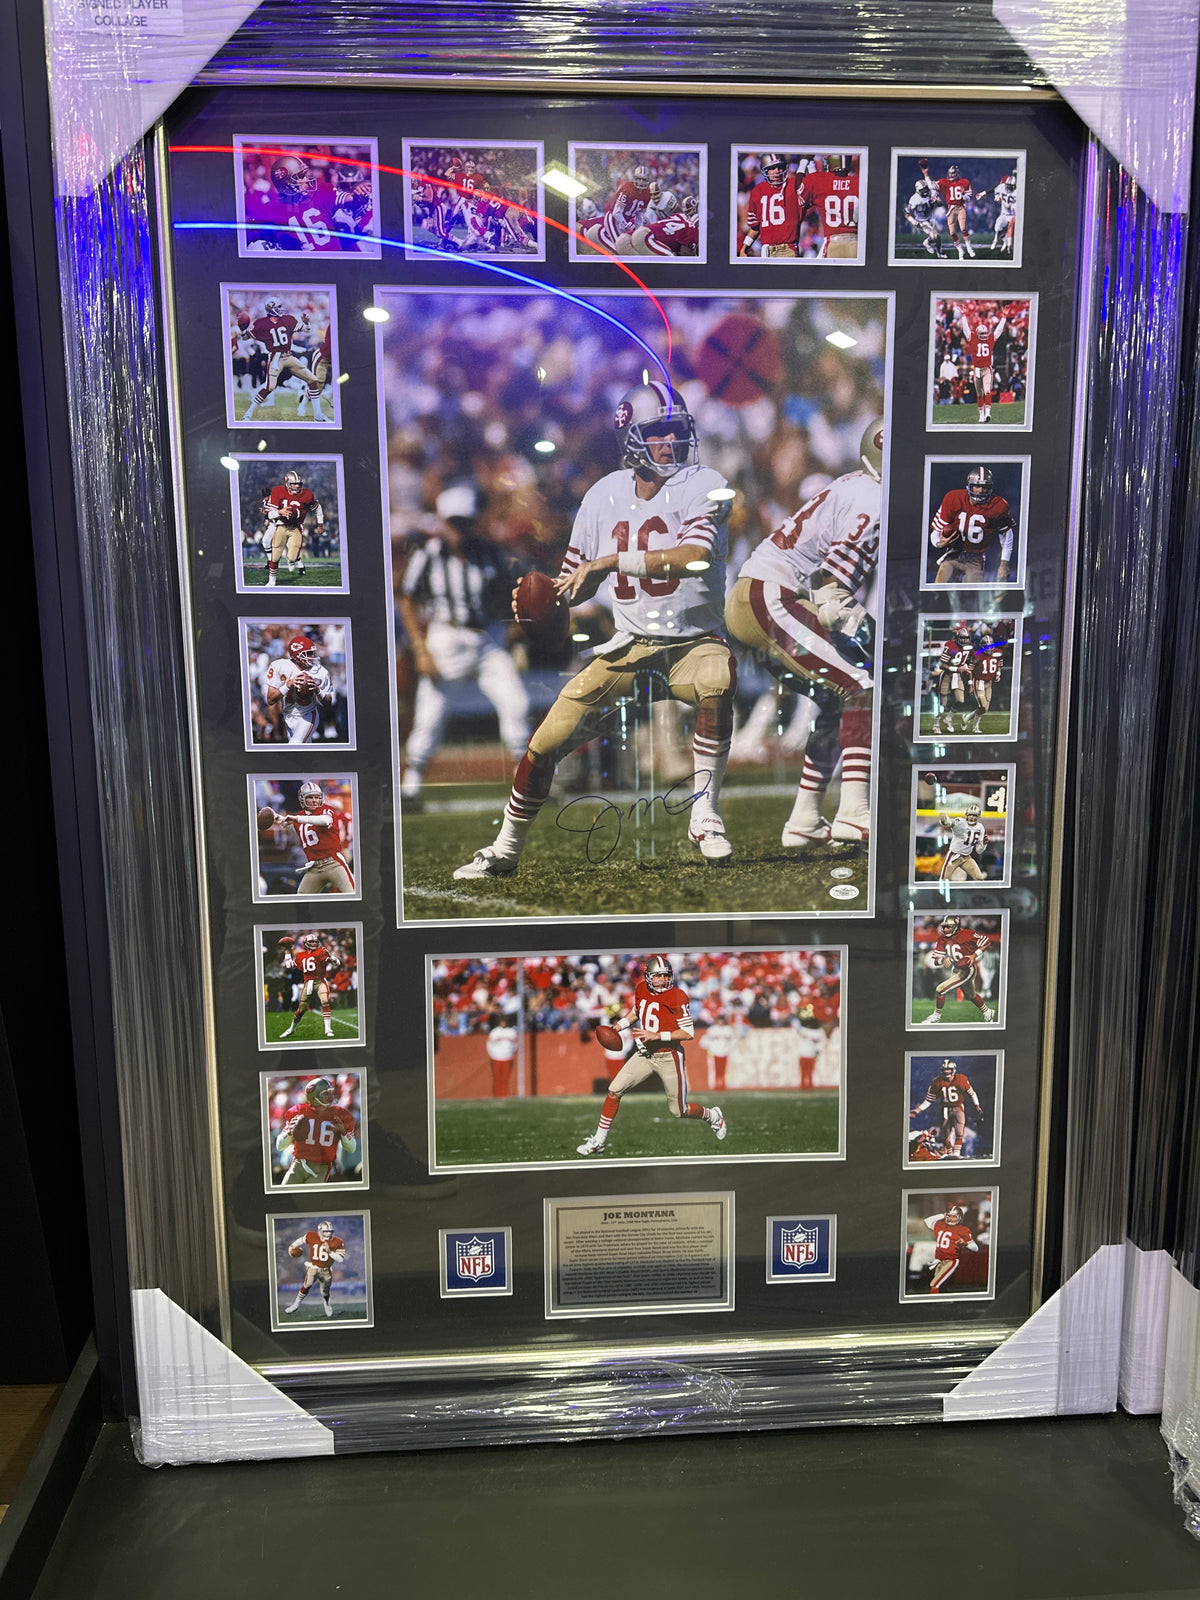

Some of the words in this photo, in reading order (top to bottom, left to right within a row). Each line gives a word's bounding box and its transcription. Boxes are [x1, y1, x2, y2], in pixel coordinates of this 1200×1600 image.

[94, 15, 149, 27] COLLAGE
[462, 178, 475, 192] 16
[832, 180, 851, 191] RICE
[949, 186, 963, 201] 16
[760, 193, 786, 228] 16
[824, 195, 859, 228] 80
[287, 207, 331, 251] 16
[270, 326, 289, 347] 16
[976, 342, 990, 358] 16
[958, 511, 986, 544] 16
[611, 515, 681, 600] 16
[982, 658, 998, 674] 16
[987, 787, 1006, 814] 4
[299, 823, 319, 849] 16
[945, 943, 963, 962] 16
[302, 956, 316, 973] 16
[638, 998, 660, 1034] 16
[941, 1085, 959, 1103] 16
[305, 1118, 336, 1147] 16
[603, 1212, 622, 1221] JOE
[623, 1210, 676, 1219] MONTANA
[936, 1229, 953, 1250] 16
[312, 1243, 329, 1262] 16
[784, 1243, 814, 1264] NFL
[460, 1256, 491, 1277] NFL
